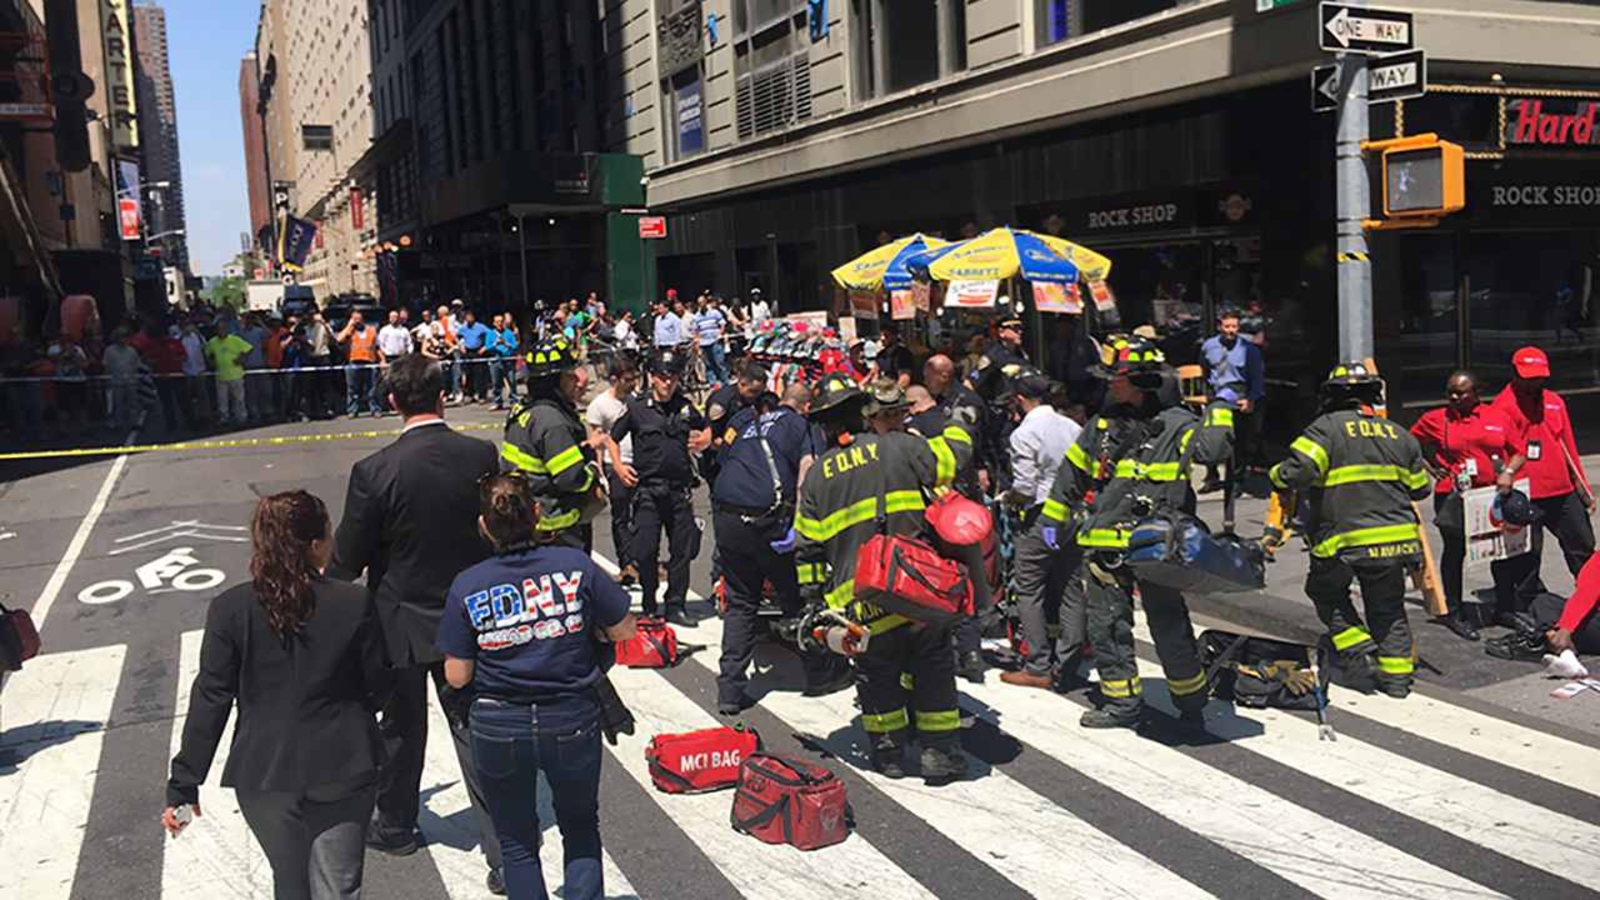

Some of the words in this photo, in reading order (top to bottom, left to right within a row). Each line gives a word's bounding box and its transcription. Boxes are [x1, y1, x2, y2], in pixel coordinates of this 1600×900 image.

[1335, 19, 1362, 37] ONE
[1375, 23, 1403, 40] WAY
[1371, 67, 1409, 87] WAY
[1514, 99, 1597, 145] Hard
[1492, 186, 1548, 205] ROCK
[1089, 209, 1130, 228] ROCK
[1133, 204, 1177, 225] SHOP
[465, 571, 583, 631] FDNY
[680, 752, 708, 773] MCI
[711, 749, 740, 768] BAG
